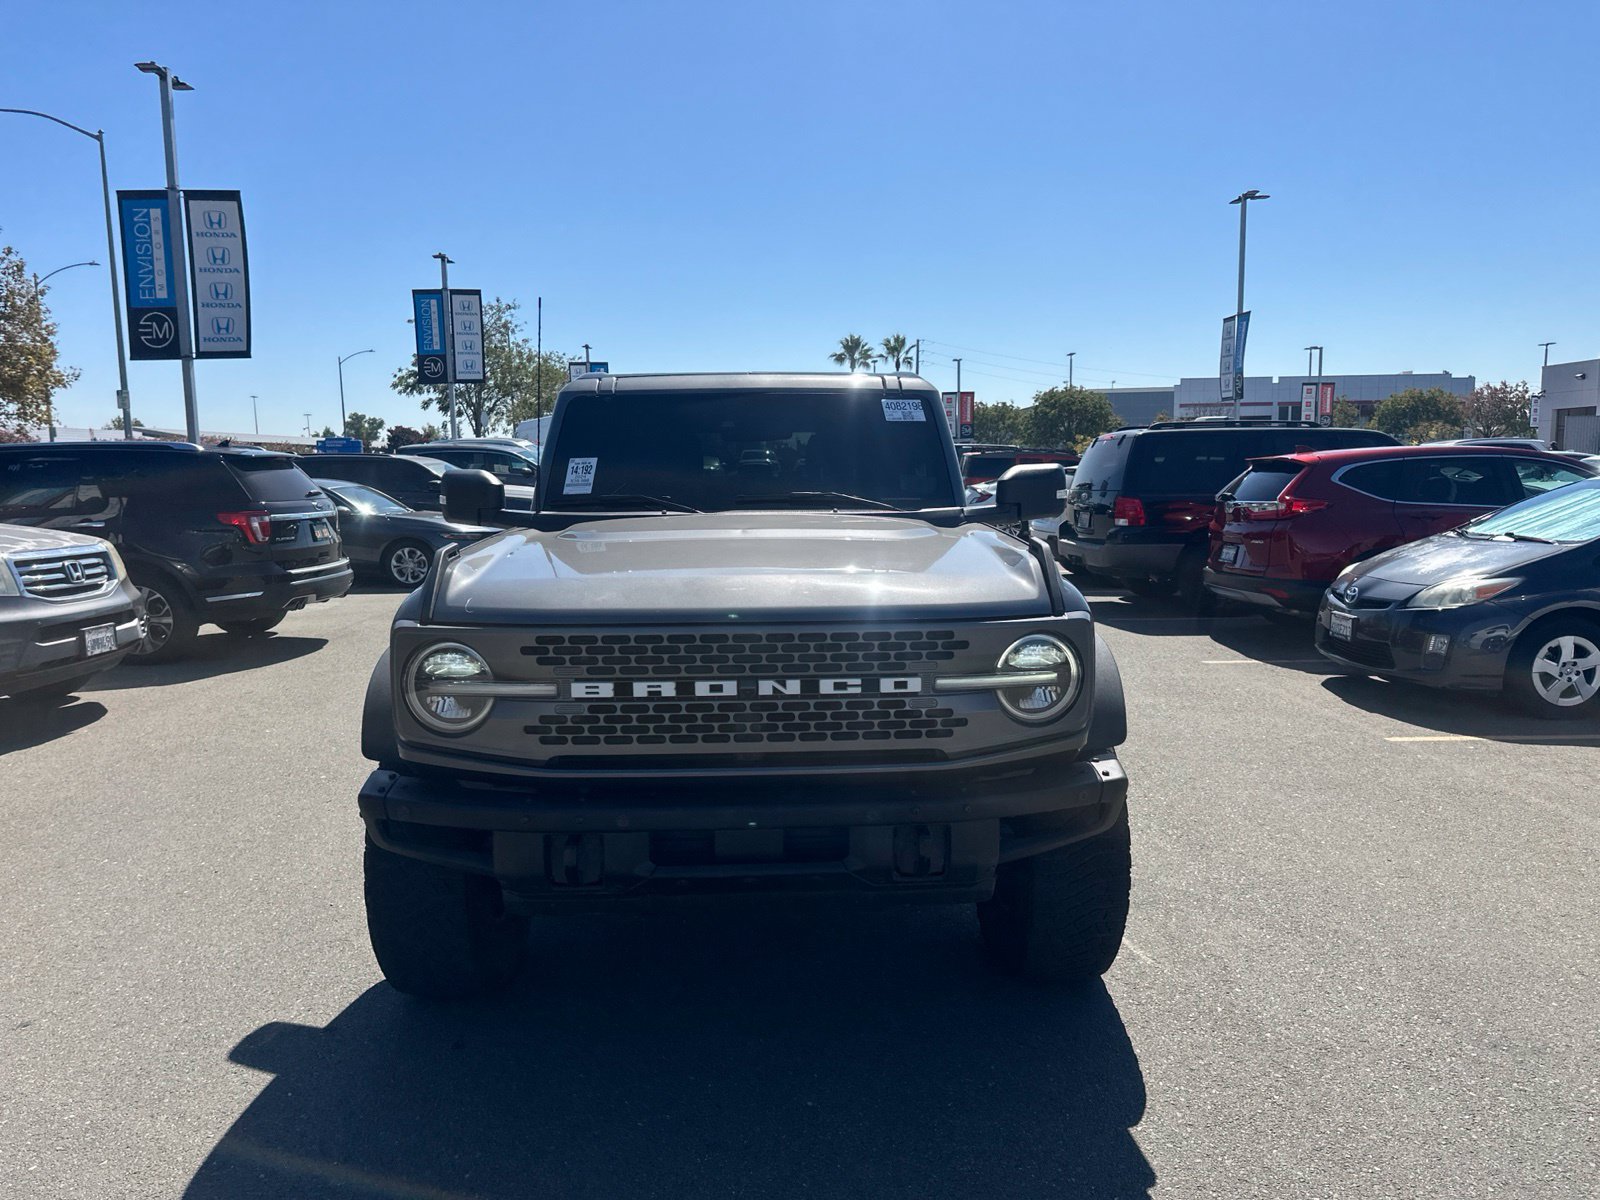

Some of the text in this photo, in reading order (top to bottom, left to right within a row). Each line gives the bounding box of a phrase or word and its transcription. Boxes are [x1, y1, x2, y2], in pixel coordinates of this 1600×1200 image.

[132, 208, 155, 299] ENVISION
[153, 216, 165, 291] MOTORS
[421, 299, 432, 350] ENVISION
[571, 465, 593, 475] 14:192
[571, 677, 922, 698] BRONCO
